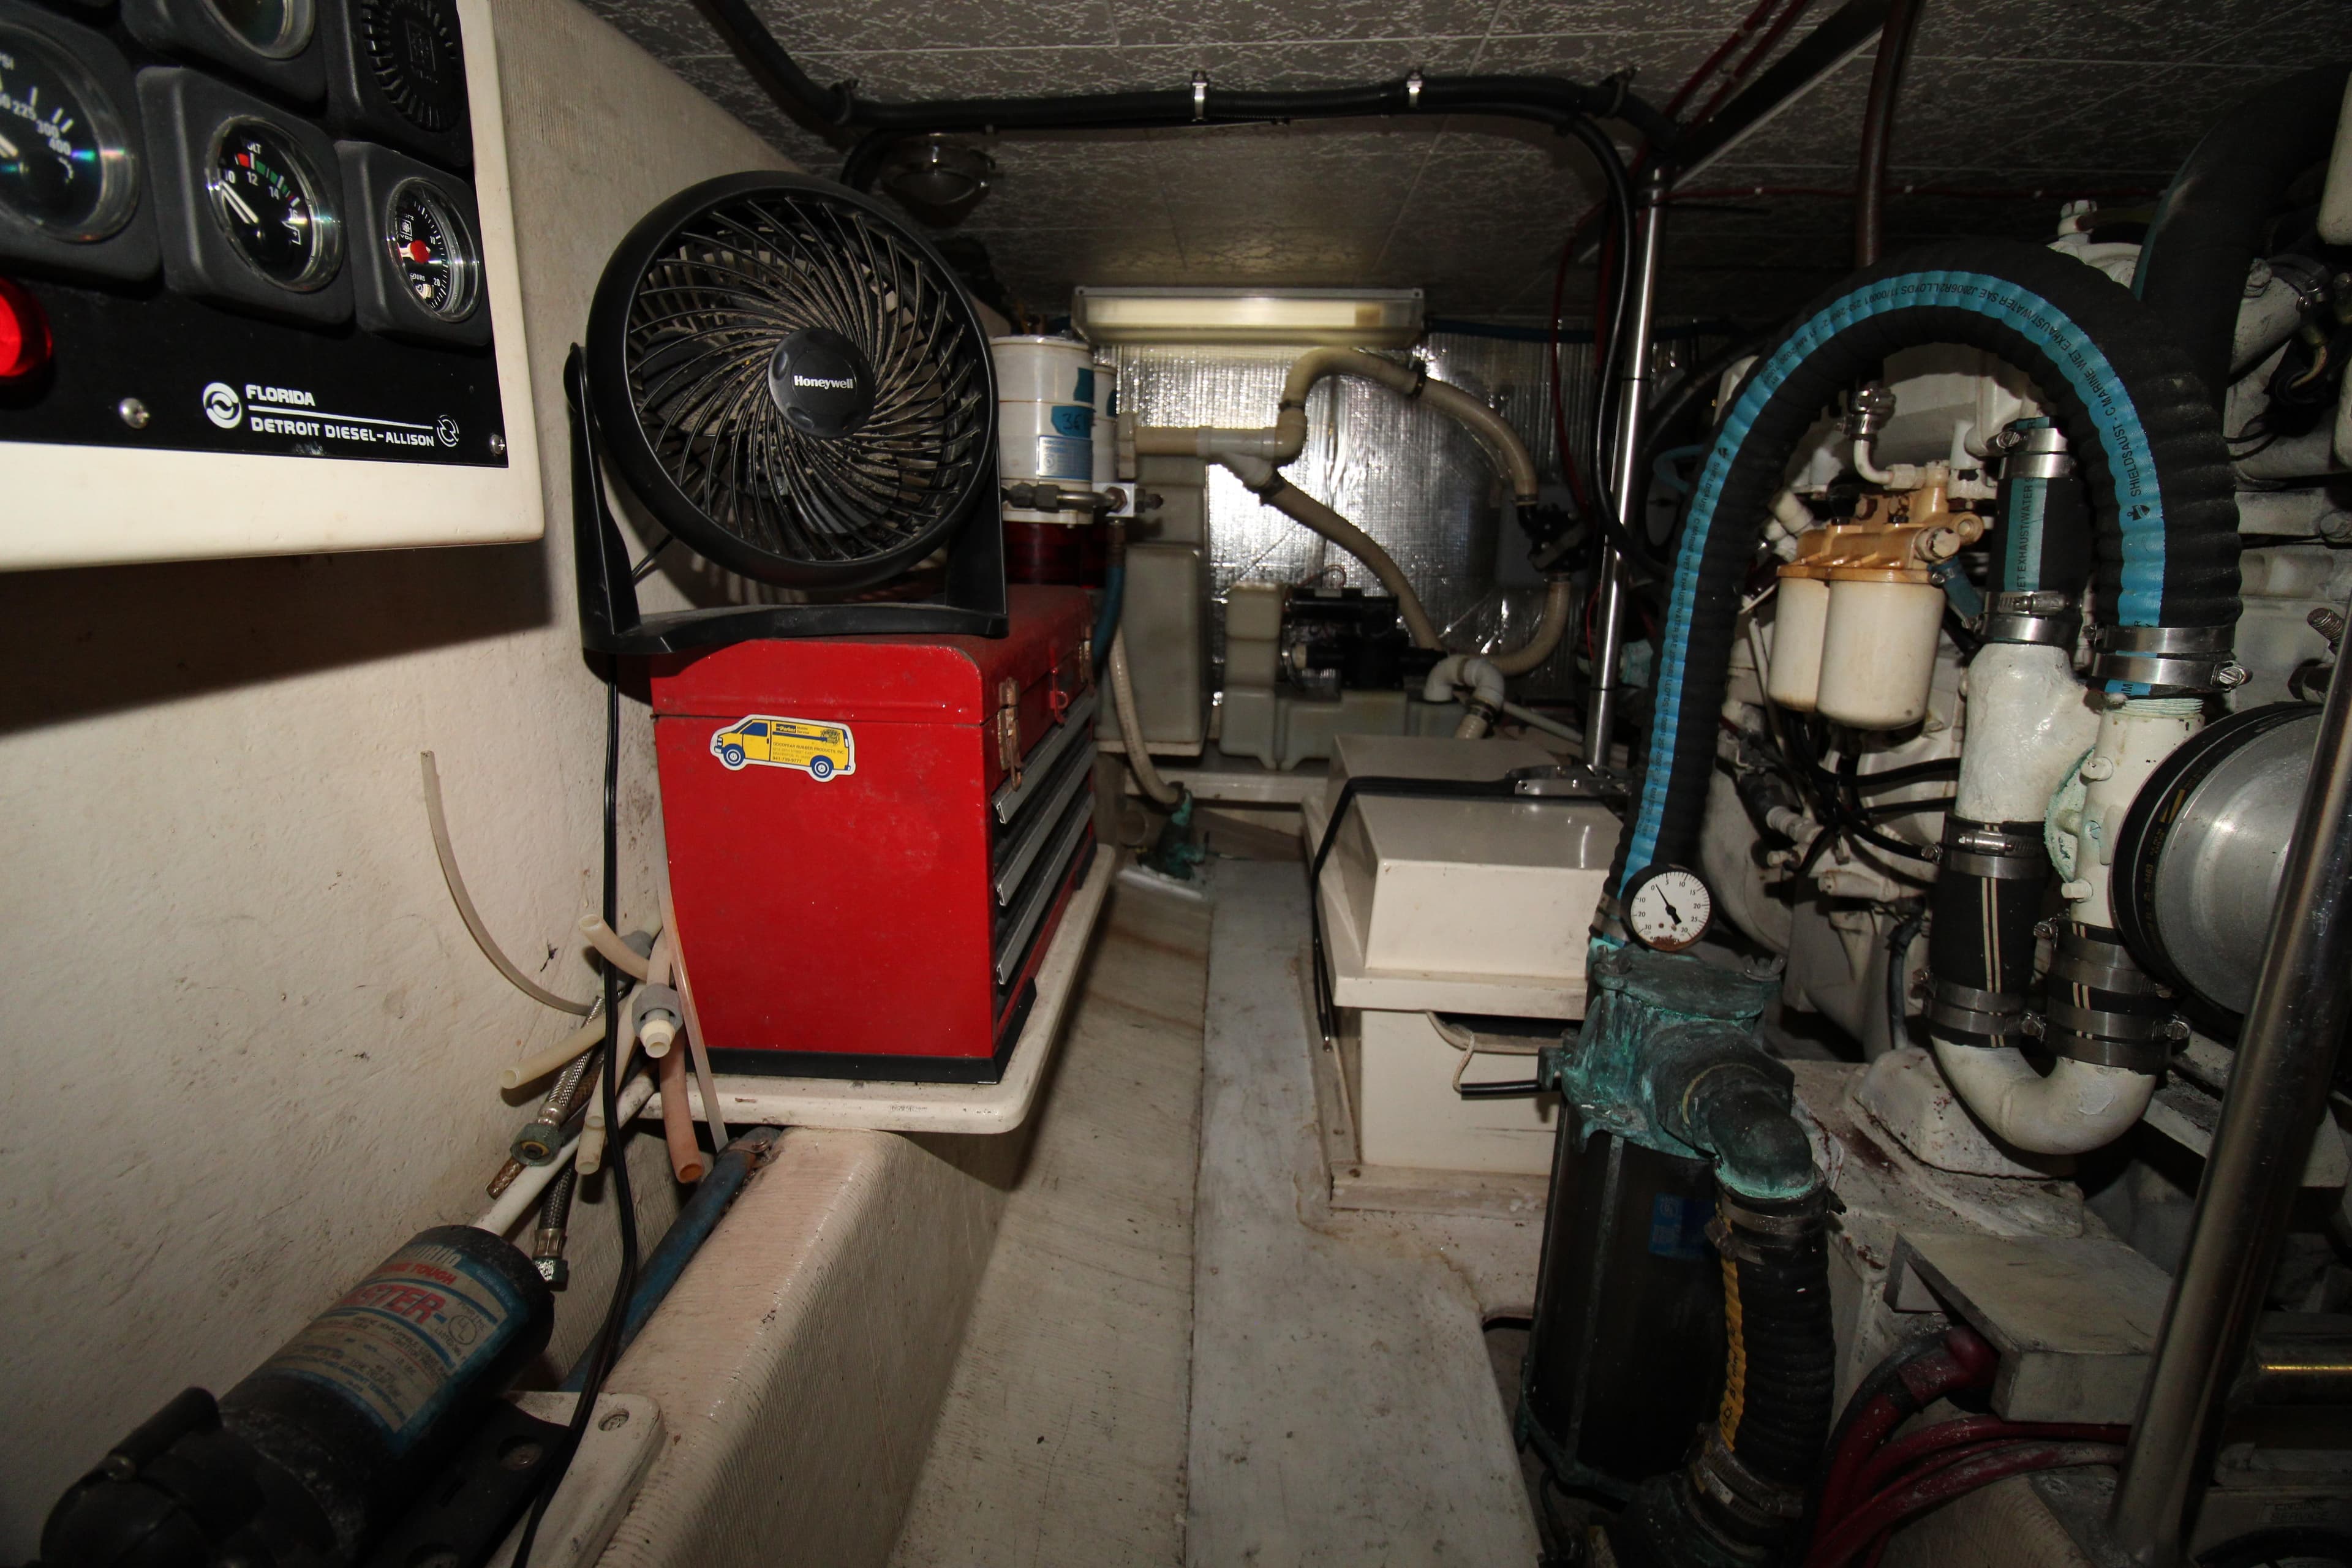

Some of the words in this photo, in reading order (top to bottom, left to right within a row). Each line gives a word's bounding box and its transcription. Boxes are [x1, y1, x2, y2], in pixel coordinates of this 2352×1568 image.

[13, 99, 37, 121] 225
[37, 120, 59, 138] 300
[49, 137, 71, 156] 400
[247, 172, 258, 186] 12
[270, 186, 279, 200] 14
[288, 208, 298, 220] 16
[430, 236, 435, 244] 10
[434, 277, 440, 287] 20
[1901, 283, 1939, 295] LLOYDS
[1978, 288, 1999, 302] SAE
[1999, 295, 2071, 351] EXHAUST/WATER
[2068, 349, 2087, 370] WET
[794, 375, 853, 390] Honeywell
[2084, 368, 2112, 407] MARINE
[246, 384, 316, 407] FLORIDA
[2105, 407, 2116, 417] C
[251, 417, 320, 437] DETROIT
[325, 425, 434, 447] DIESEL-ALLISON
[2113, 424, 2141, 497] SHIELDSAUST
[2018, 484, 2032, 572] EXHAUST/WATER
[1687, 527, 1701, 552] MARINE
[411, 1263, 457, 1285] TOUGH
